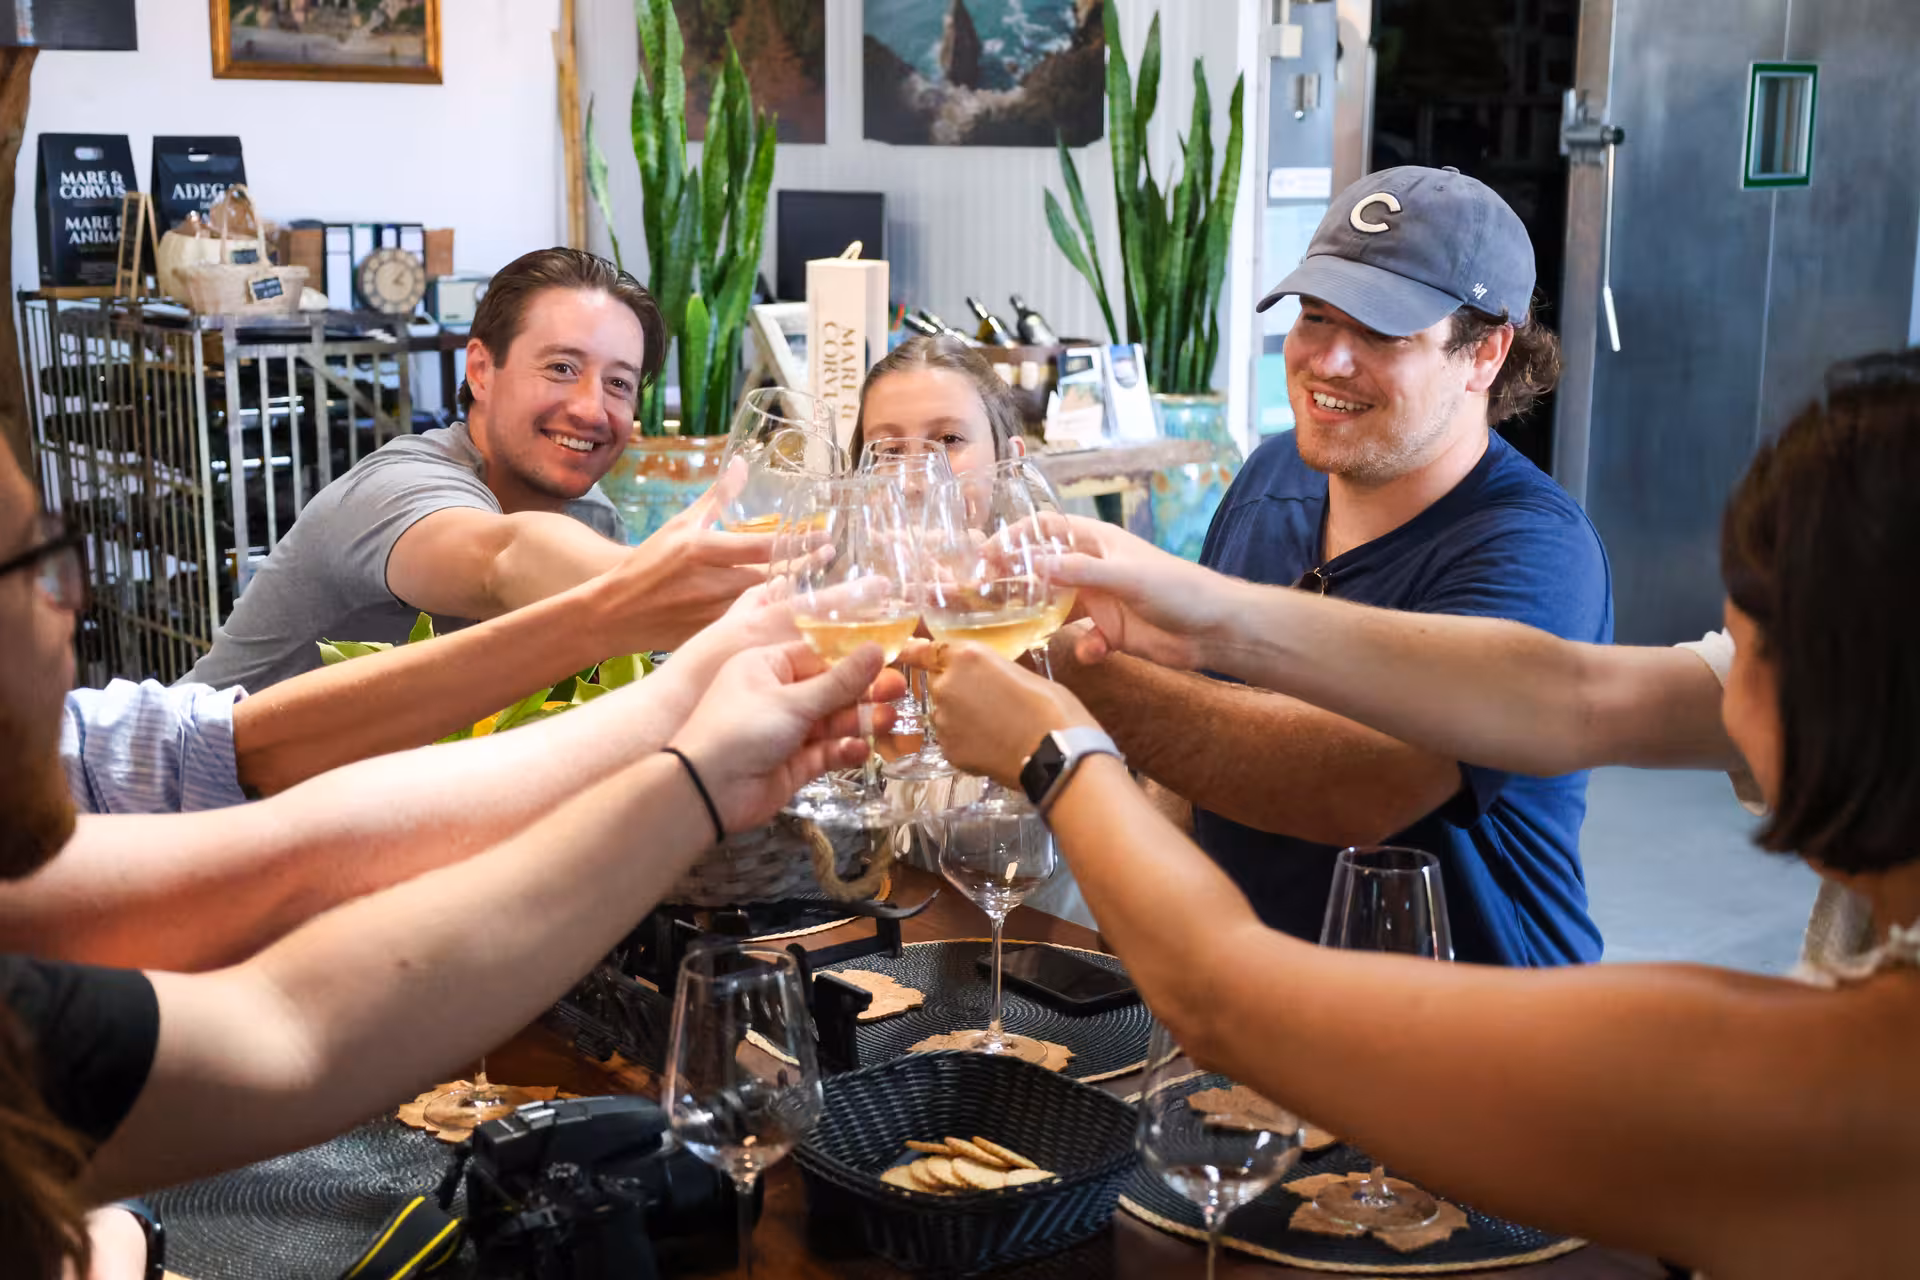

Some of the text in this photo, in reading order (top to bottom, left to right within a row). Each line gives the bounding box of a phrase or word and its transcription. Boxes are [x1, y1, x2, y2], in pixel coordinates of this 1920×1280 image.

[61, 171, 107, 185] MARE
[60, 184, 126, 199] CORVUS
[172, 183, 235, 200] ADEG
[1350, 192, 1401, 233] C
[65, 216, 112, 231] MARE
